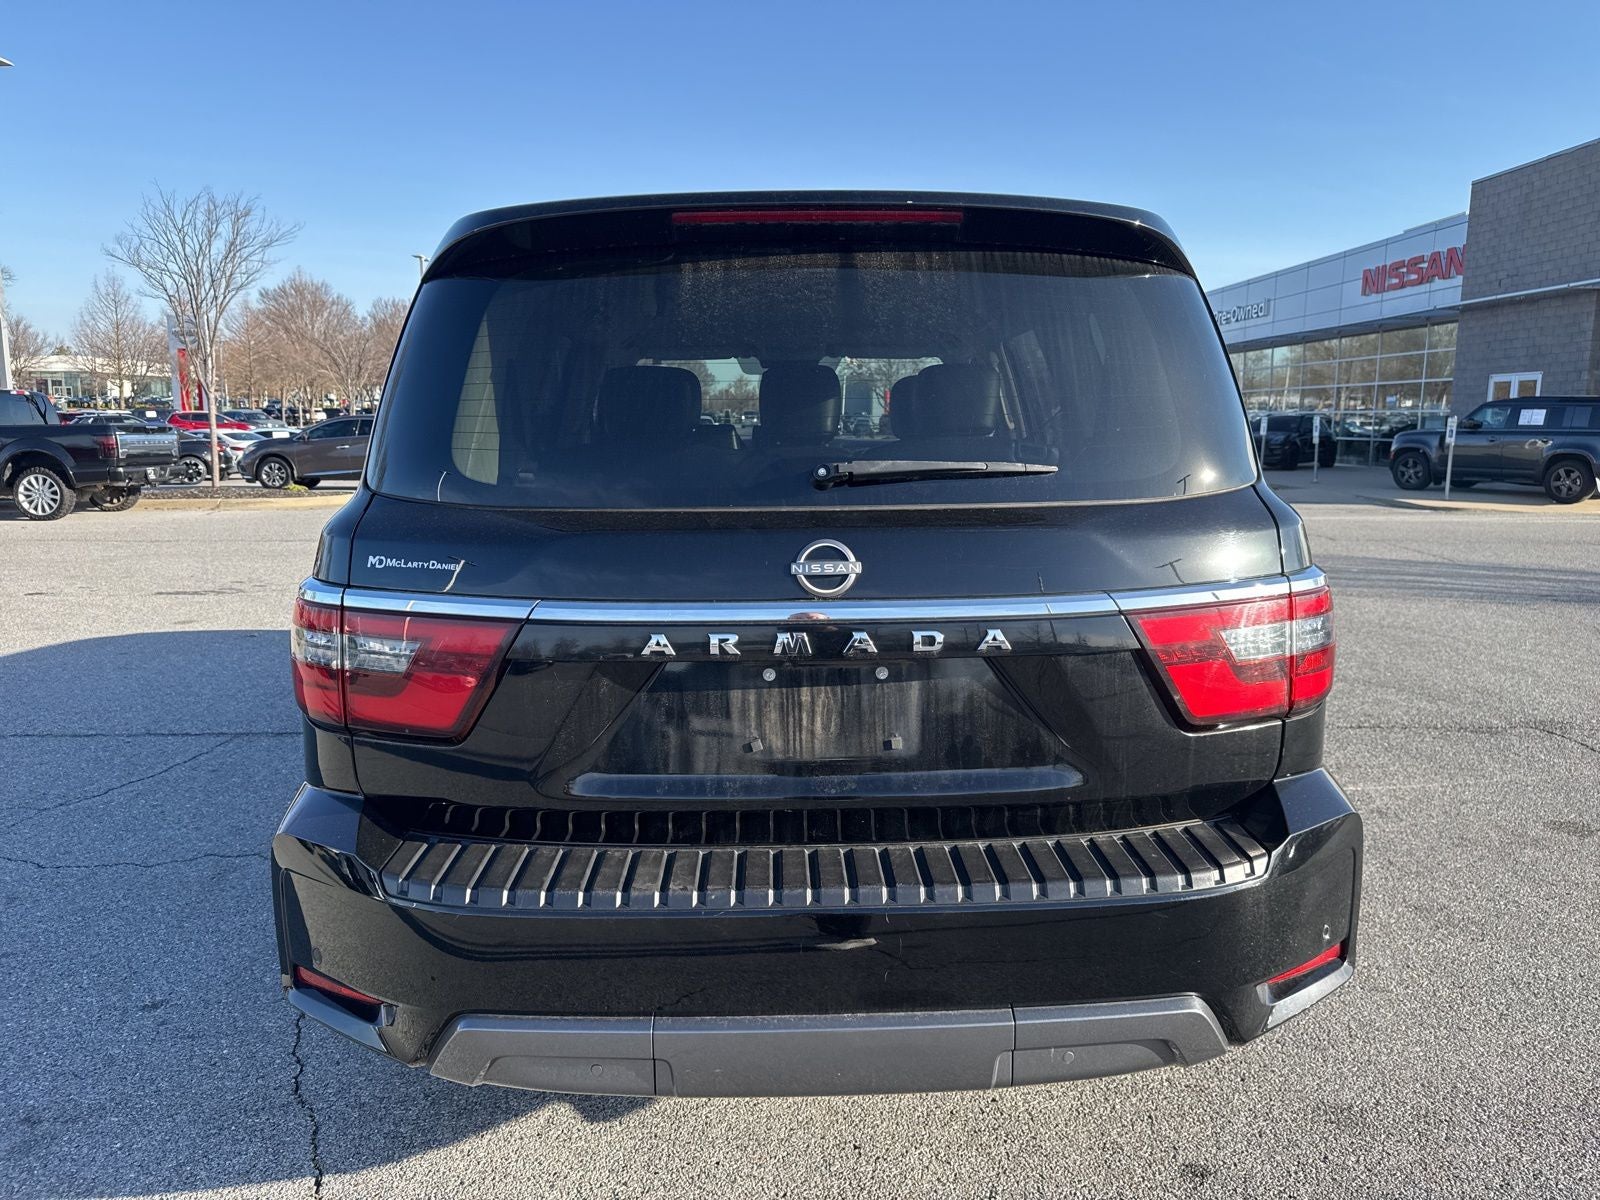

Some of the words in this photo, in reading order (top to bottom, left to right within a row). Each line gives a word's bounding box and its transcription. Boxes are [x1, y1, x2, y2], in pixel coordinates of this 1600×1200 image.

[1361, 244, 1466, 296] NISSAN
[792, 563, 860, 573] NISSAN
[640, 628, 1013, 656] ARMADA
